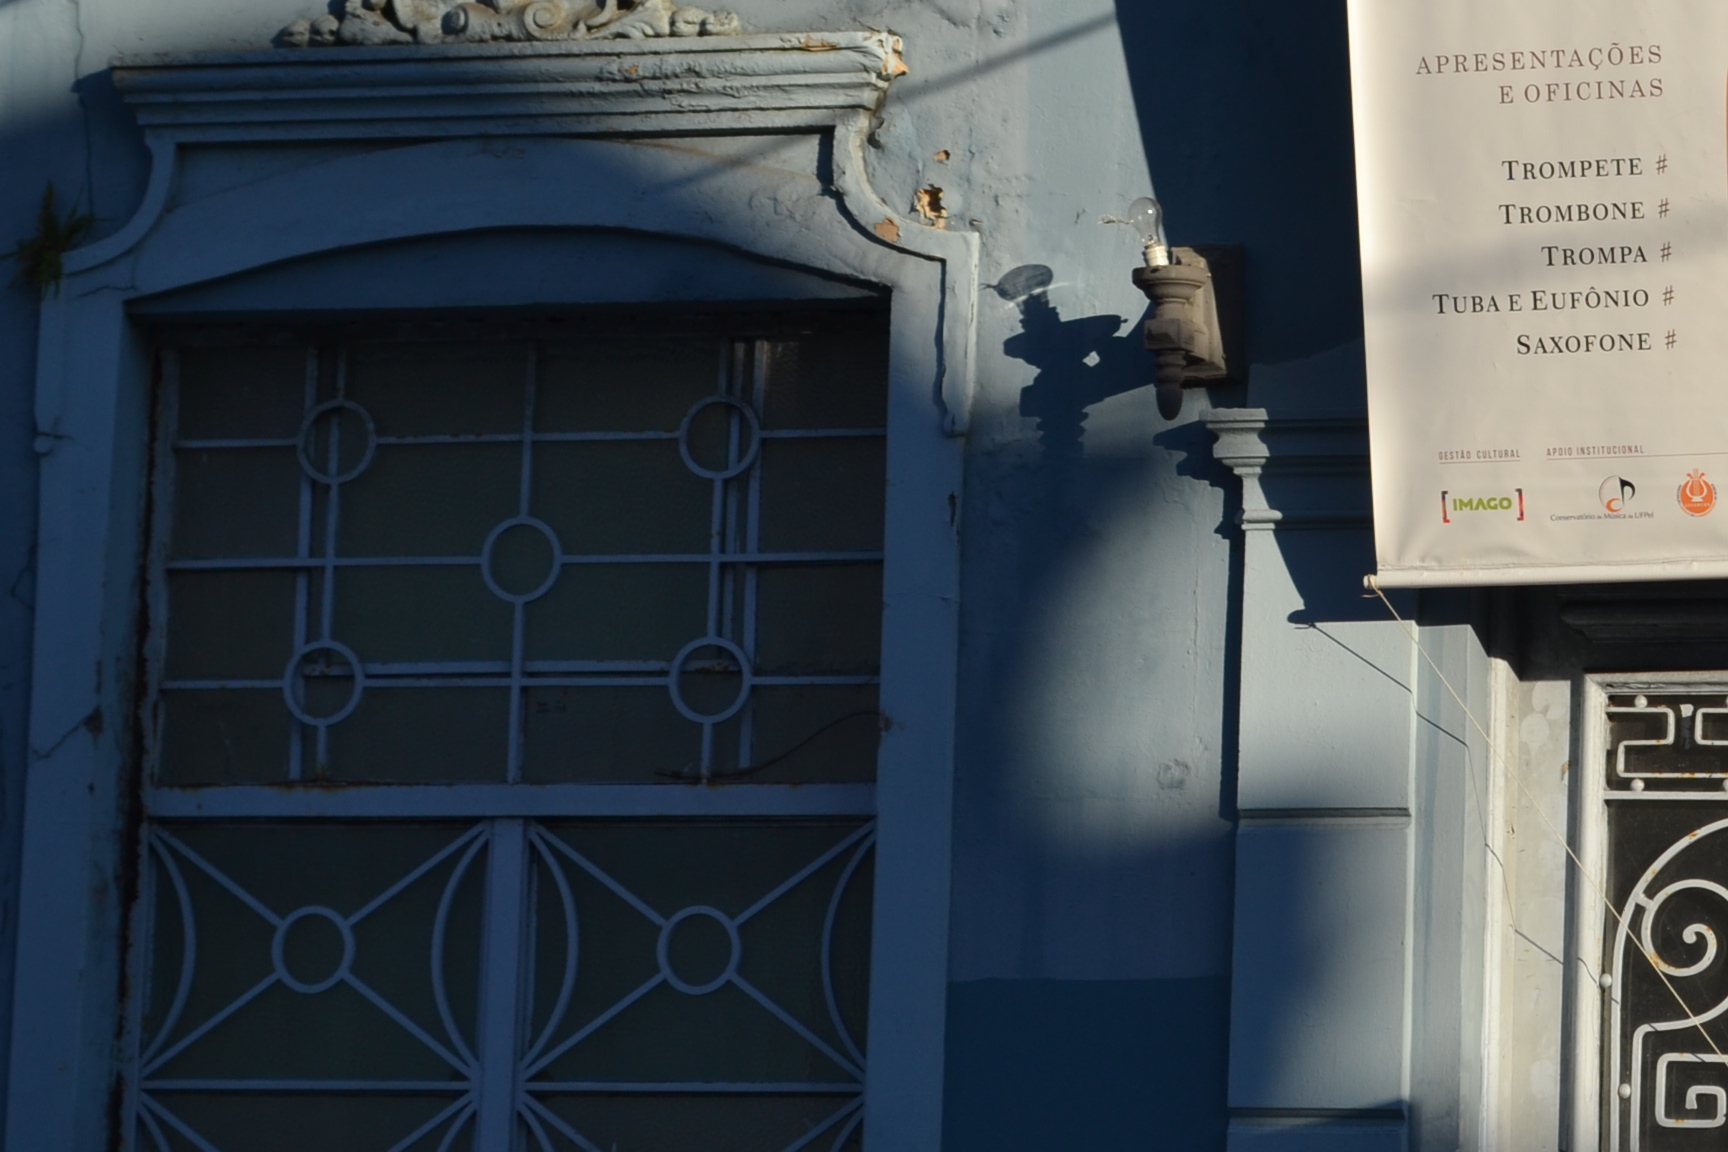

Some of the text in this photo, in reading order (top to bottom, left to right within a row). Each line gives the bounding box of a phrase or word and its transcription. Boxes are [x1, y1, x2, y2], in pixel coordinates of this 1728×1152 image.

[1416, 43, 1662, 76] APRESENTAÇÕES
[1499, 78, 1664, 104] E OFICINAS
[1501, 157, 1643, 181] TROMPETE
[1498, 201, 1645, 225] TROMBONE
[1541, 245, 1648, 267] TROMPA
[1432, 293, 1500, 315] TUBA
[1508, 294, 1523, 312] E
[1516, 332, 1652, 355] SAXOFONE
[1438, 448, 1521, 461] GESTÃO CULTURAL
[1546, 445, 1645, 457] APOIO INSTITUCIONAL
[1452, 497, 1513, 512] IMAGO
